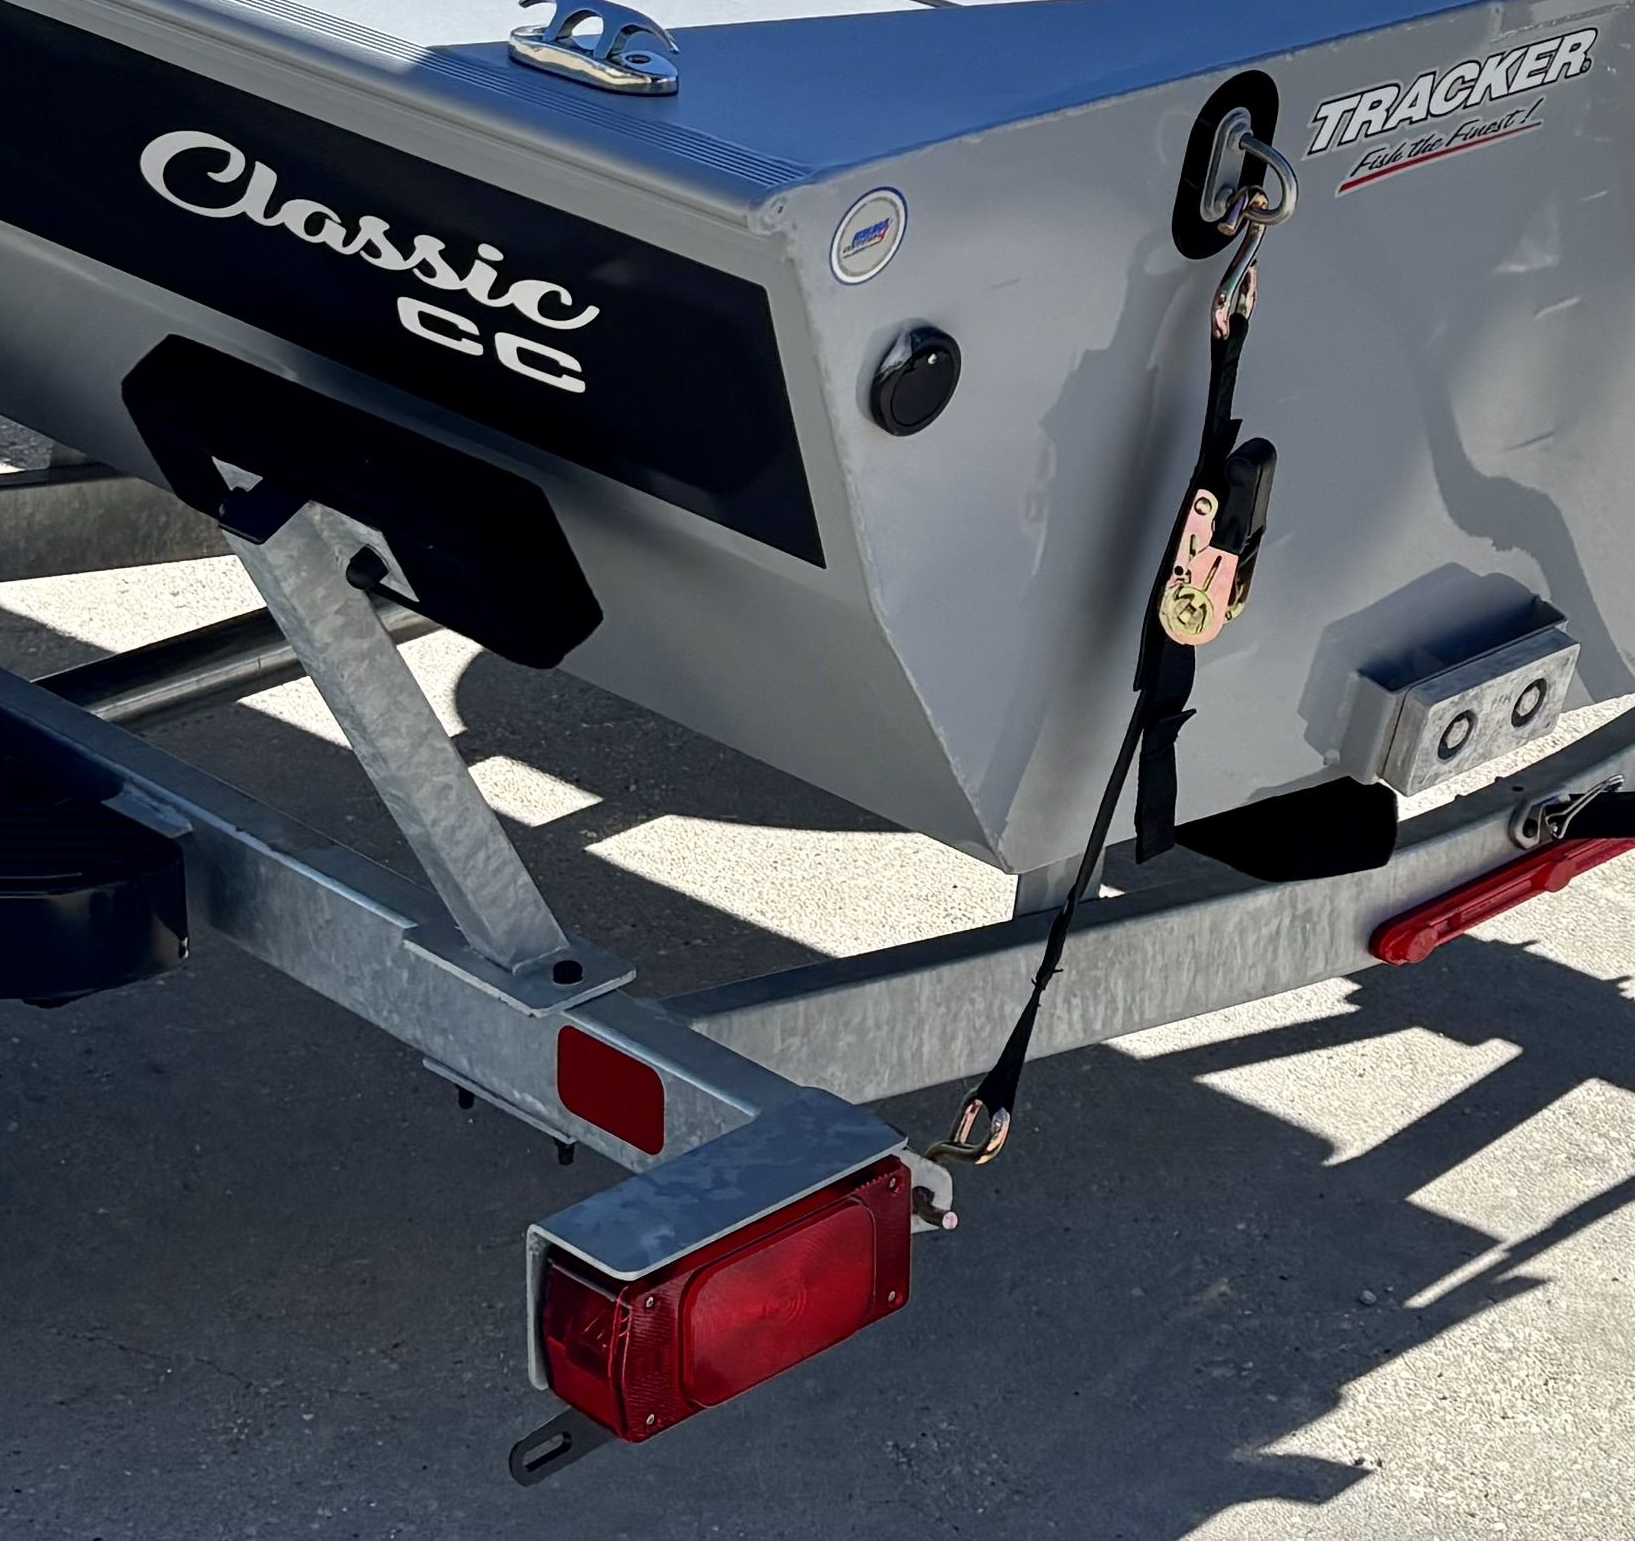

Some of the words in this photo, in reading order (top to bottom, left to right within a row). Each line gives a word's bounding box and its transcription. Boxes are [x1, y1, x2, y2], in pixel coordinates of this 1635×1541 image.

[1350, 146, 1403, 178] Fish
[140, 130, 600, 330] Classic
[397, 296, 586, 393] CC
